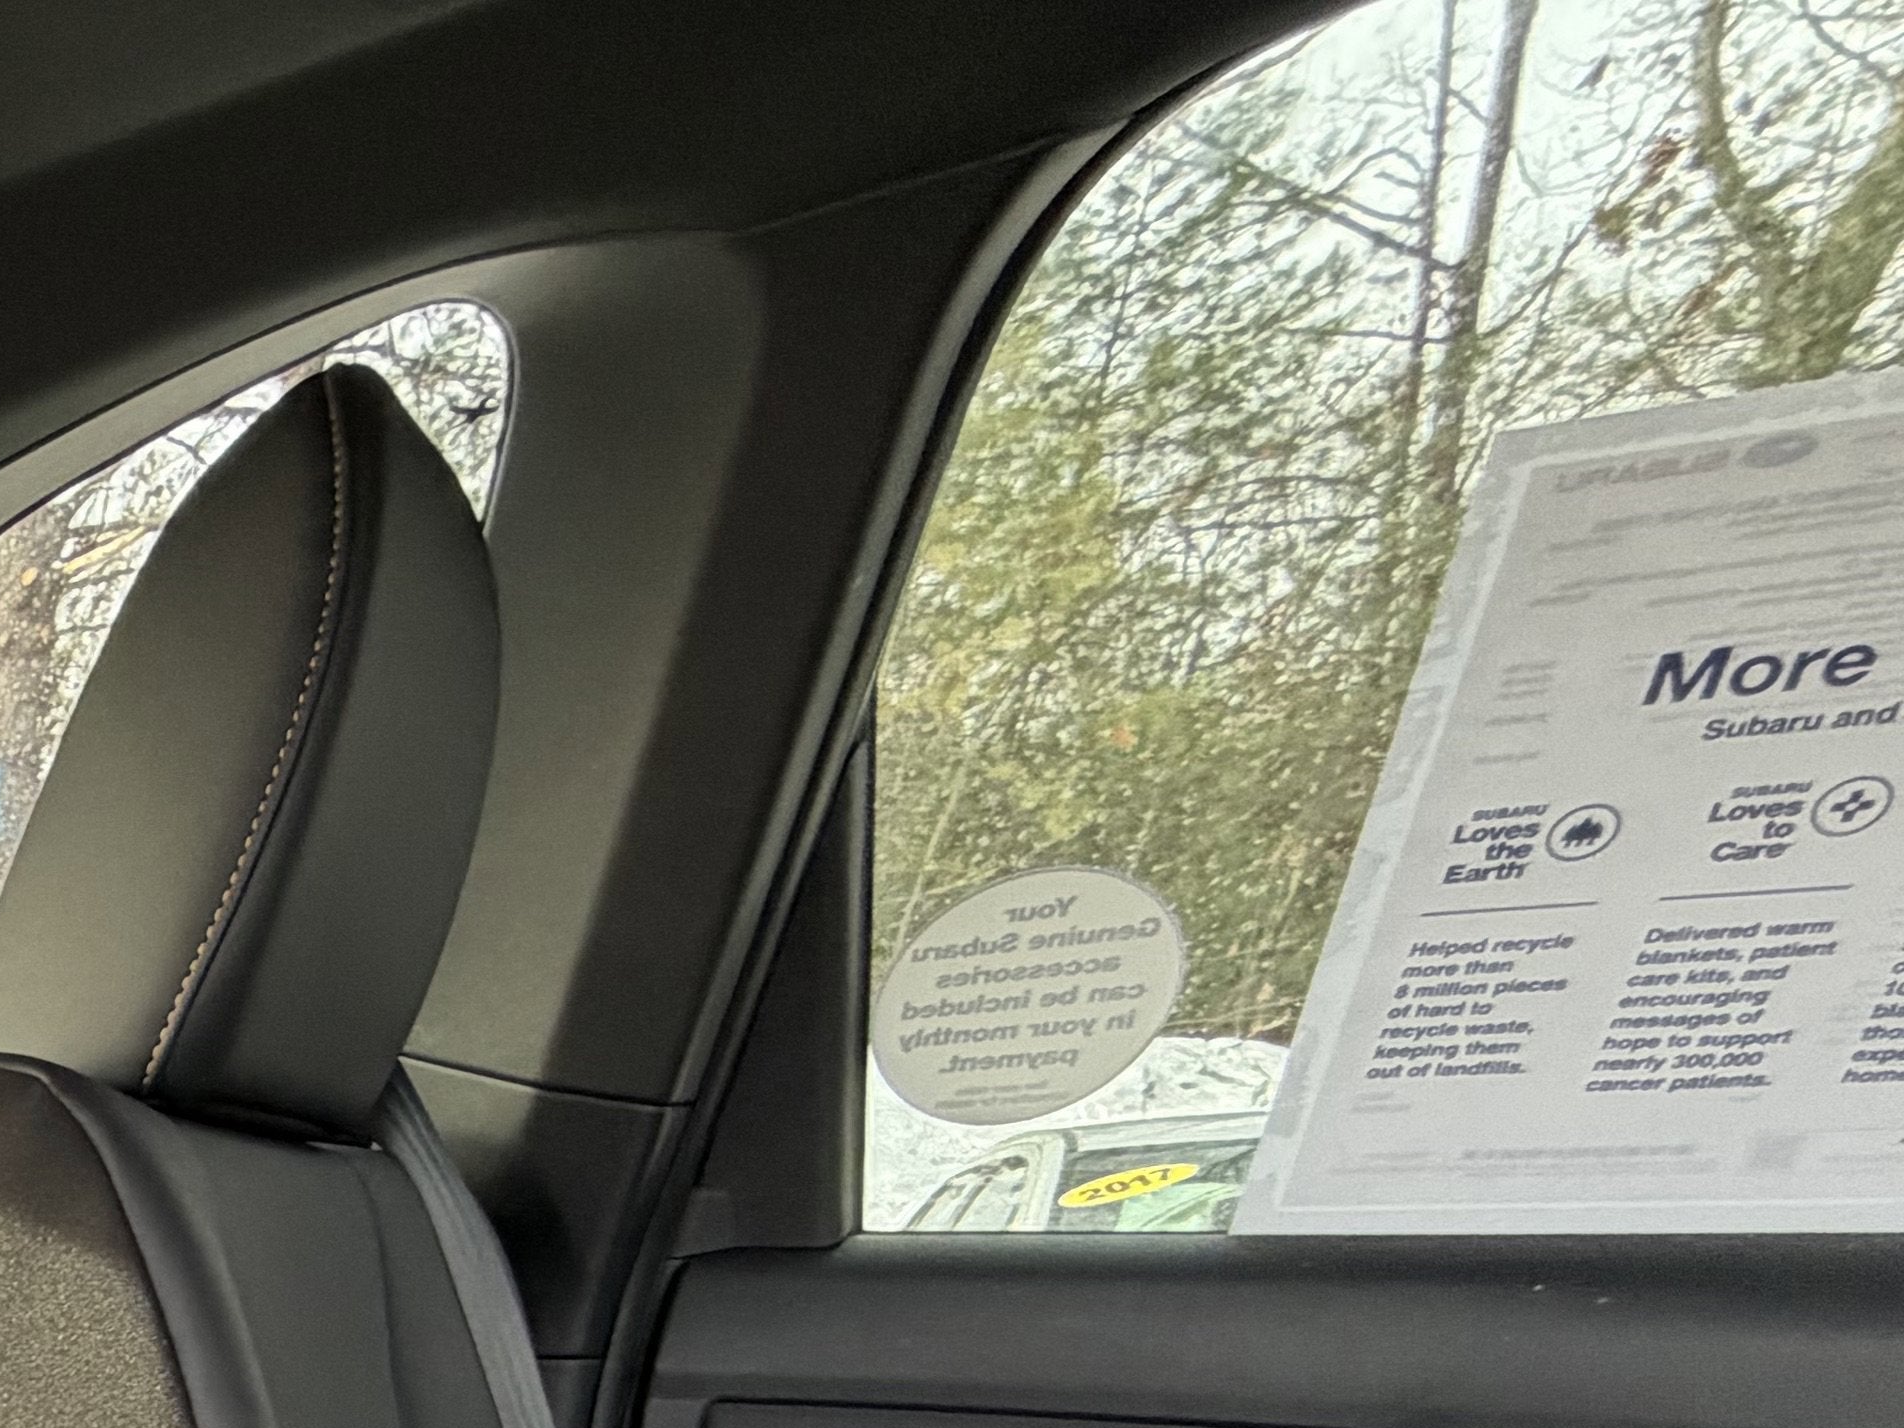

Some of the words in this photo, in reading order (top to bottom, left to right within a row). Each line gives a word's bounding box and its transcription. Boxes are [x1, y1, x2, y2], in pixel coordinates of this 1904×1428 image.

[1642, 644, 1879, 706] More
[1701, 713, 1826, 741] Subaru
[1830, 700, 1904, 730] and
[1730, 779, 1814, 799] SUBARU
[1471, 804, 1550, 822] SUBARU
[1707, 800, 1808, 823] Loves
[1451, 822, 1541, 844] Loves
[1762, 820, 1796, 839] to
[1485, 842, 1533, 861] the
[1710, 841, 1797, 862] Care
[1441, 861, 1532, 884] Earth
[1643, 922, 1763, 944] Delivered
[1765, 921, 1837, 936] warm
[1406, 937, 1489, 959] Helped
[1491, 933, 1576, 954] recycle
[1635, 946, 1744, 967] blankets,
[1748, 941, 1839, 963] patient
[1400, 962, 1460, 979] more
[1464, 960, 1515, 975] than
[1626, 972, 1680, 988] care
[1683, 968, 1735, 986] kits,
[1741, 964, 1791, 982] and
[1393, 983, 1410, 1000] 8
[1412, 981, 1490, 998] million
[1492, 978, 1569, 998] pieces
[1618, 989, 1772, 1009] encouraging
[1387, 1004, 1412, 1019] of
[1414, 1002, 1467, 1018] hard
[1470, 1001, 1495, 1016] to
[1609, 1011, 1732, 1030] messages
[1736, 1008, 1767, 1025] of
[1379, 1022, 1459, 1041] recycle
[1601, 1035, 1661, 1054] hope
[1666, 1033, 1692, 1048] to
[1695, 1029, 1795, 1049] support
[1373, 1043, 1460, 1060] keeping
[1465, 1040, 1522, 1055] them
[1365, 1064, 1404, 1080] out
[1406, 1063, 1432, 1078] of
[1434, 1060, 1527, 1076] landfills.
[1591, 1055, 1667, 1074] nearly
[1670, 1051, 1766, 1070] 300,000
[1585, 1077, 1667, 1093] cancer
[1666, 1073, 1772, 1094] patients.
[1079, 1168, 1172, 1201] 2017
